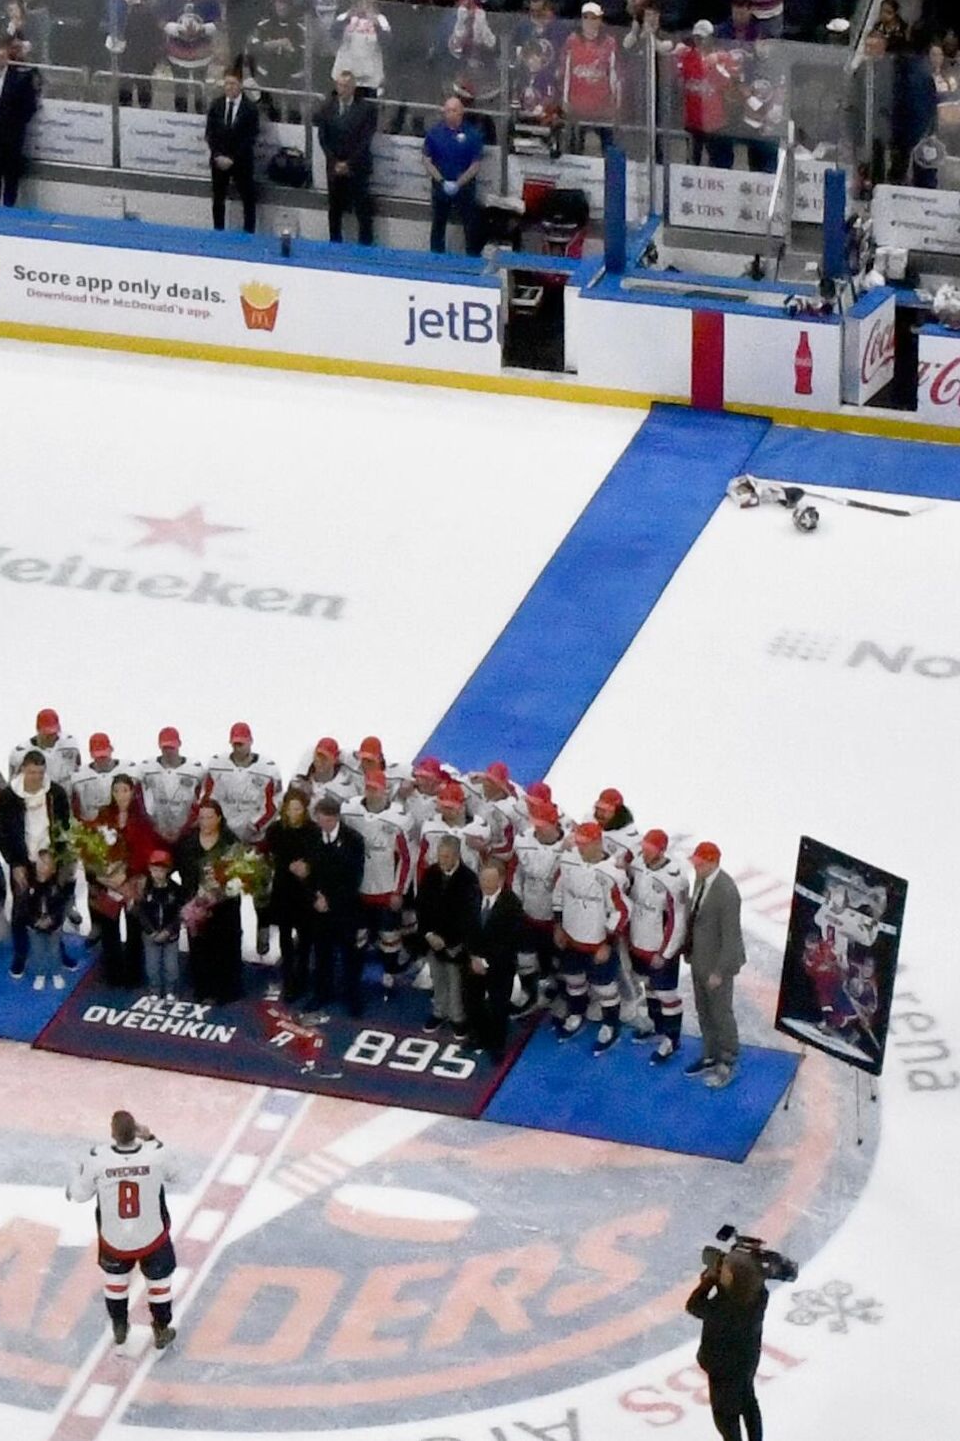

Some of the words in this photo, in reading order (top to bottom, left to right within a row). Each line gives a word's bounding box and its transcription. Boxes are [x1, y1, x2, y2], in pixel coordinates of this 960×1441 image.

[13, 264, 71, 286] Score
[76, 275, 113, 293] app
[118, 279, 161, 300] only
[166, 282, 227, 304] deals.
[83, 1005, 237, 1043] OVECHKIN
[131, 994, 212, 1020] ALEX
[343, 1029, 476, 1079] 895
[105, 1165, 150, 1178] OVECHKIN
[118, 1180, 140, 1220] 8
